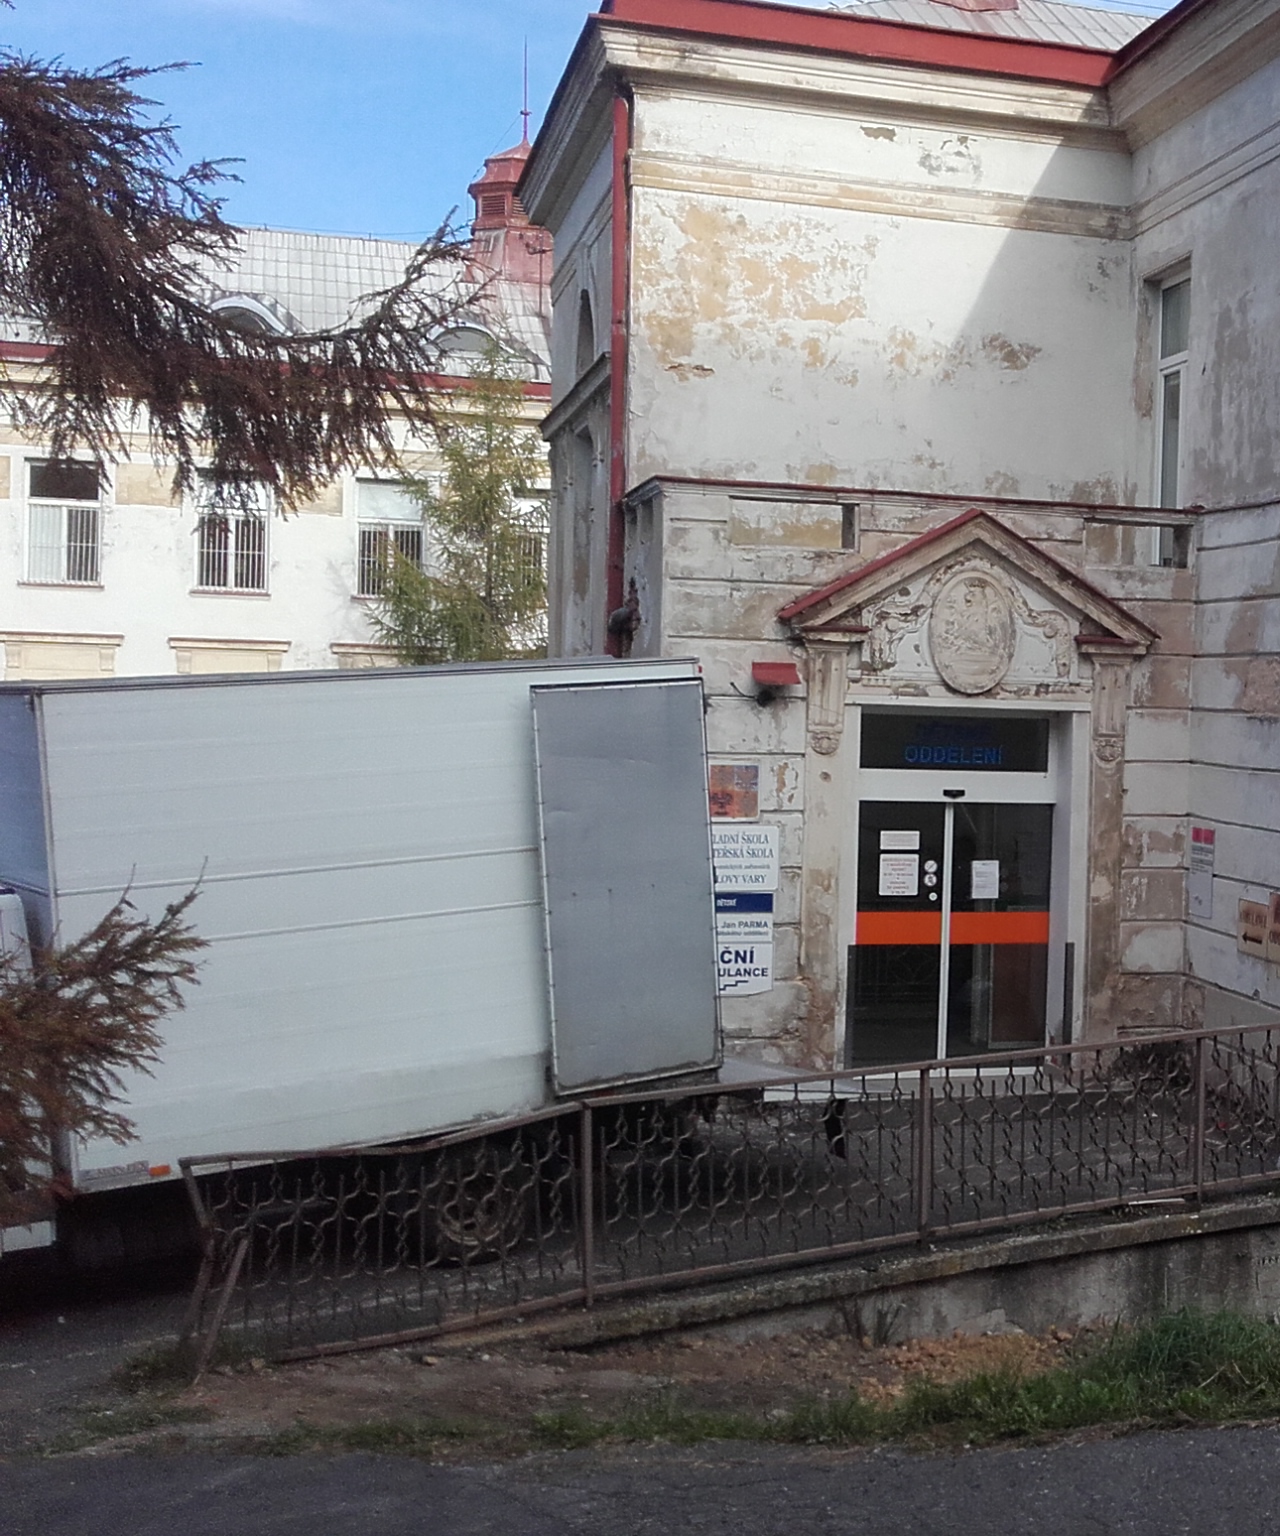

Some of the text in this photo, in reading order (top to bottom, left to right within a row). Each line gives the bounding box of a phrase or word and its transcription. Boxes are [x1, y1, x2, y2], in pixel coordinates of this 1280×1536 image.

[713, 831, 769, 844] LADNÍ ŠKOLA
[713, 845, 774, 858] TEŘSKÁ ŠKOLA
[716, 874, 766, 883] LOVY VARY
[721, 920, 769, 929] Jan PARMA
[720, 945, 755, 965] ČNÍ
[718, 967, 769, 978] ULANCE
